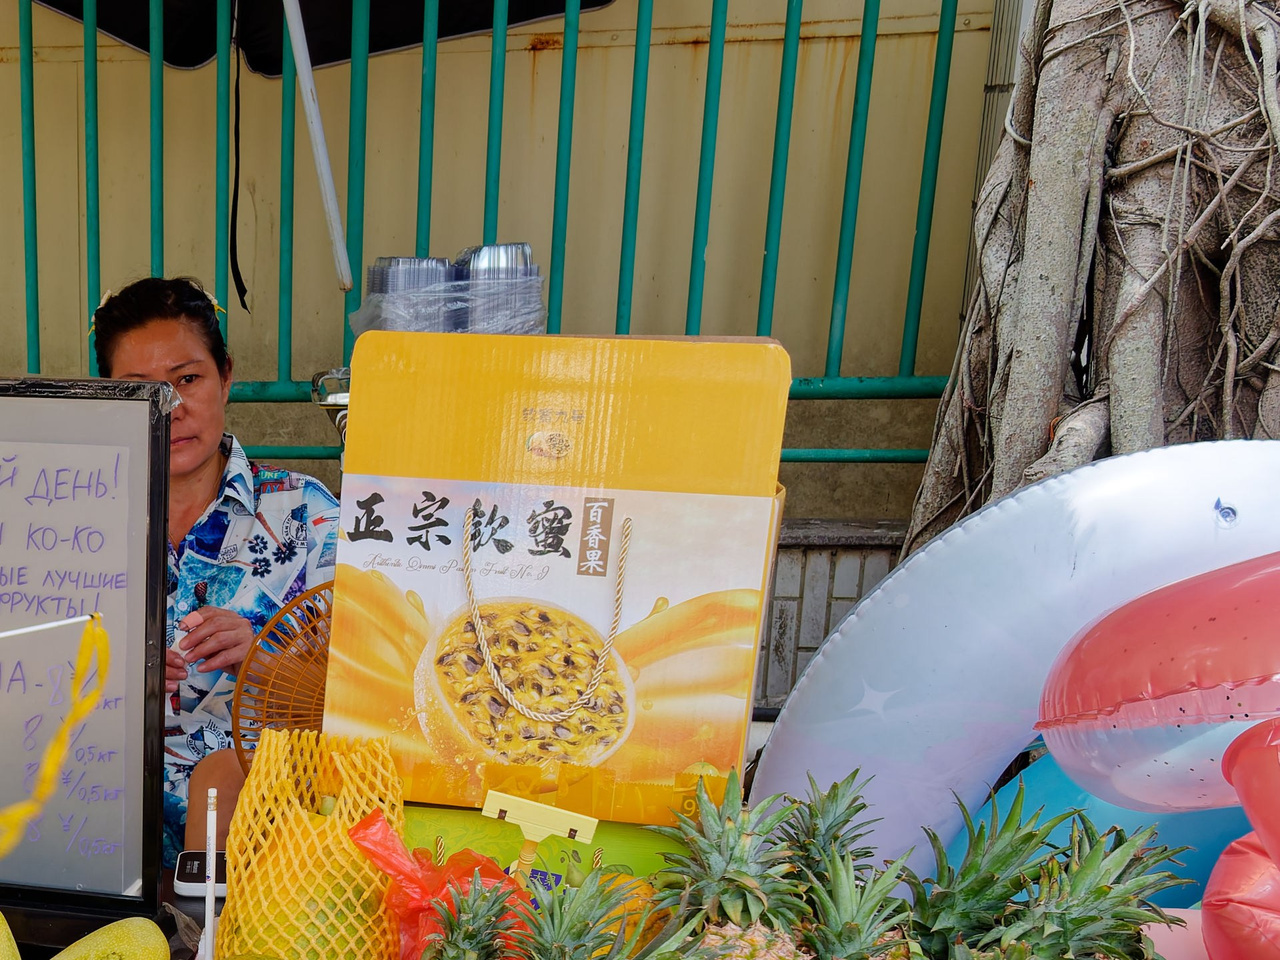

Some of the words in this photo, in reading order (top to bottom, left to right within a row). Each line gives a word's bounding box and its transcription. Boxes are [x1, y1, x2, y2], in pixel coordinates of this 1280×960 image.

[24, 452, 121, 507] ДЕНЬ!
[26, 522, 106, 554] КО-КО
[579, 499, 611, 576] 百香果
[42, 568, 129, 592] ЛУЧШИЕ
[22, 713, 44, 752] 8
[683, 798, 700, 817] 9
